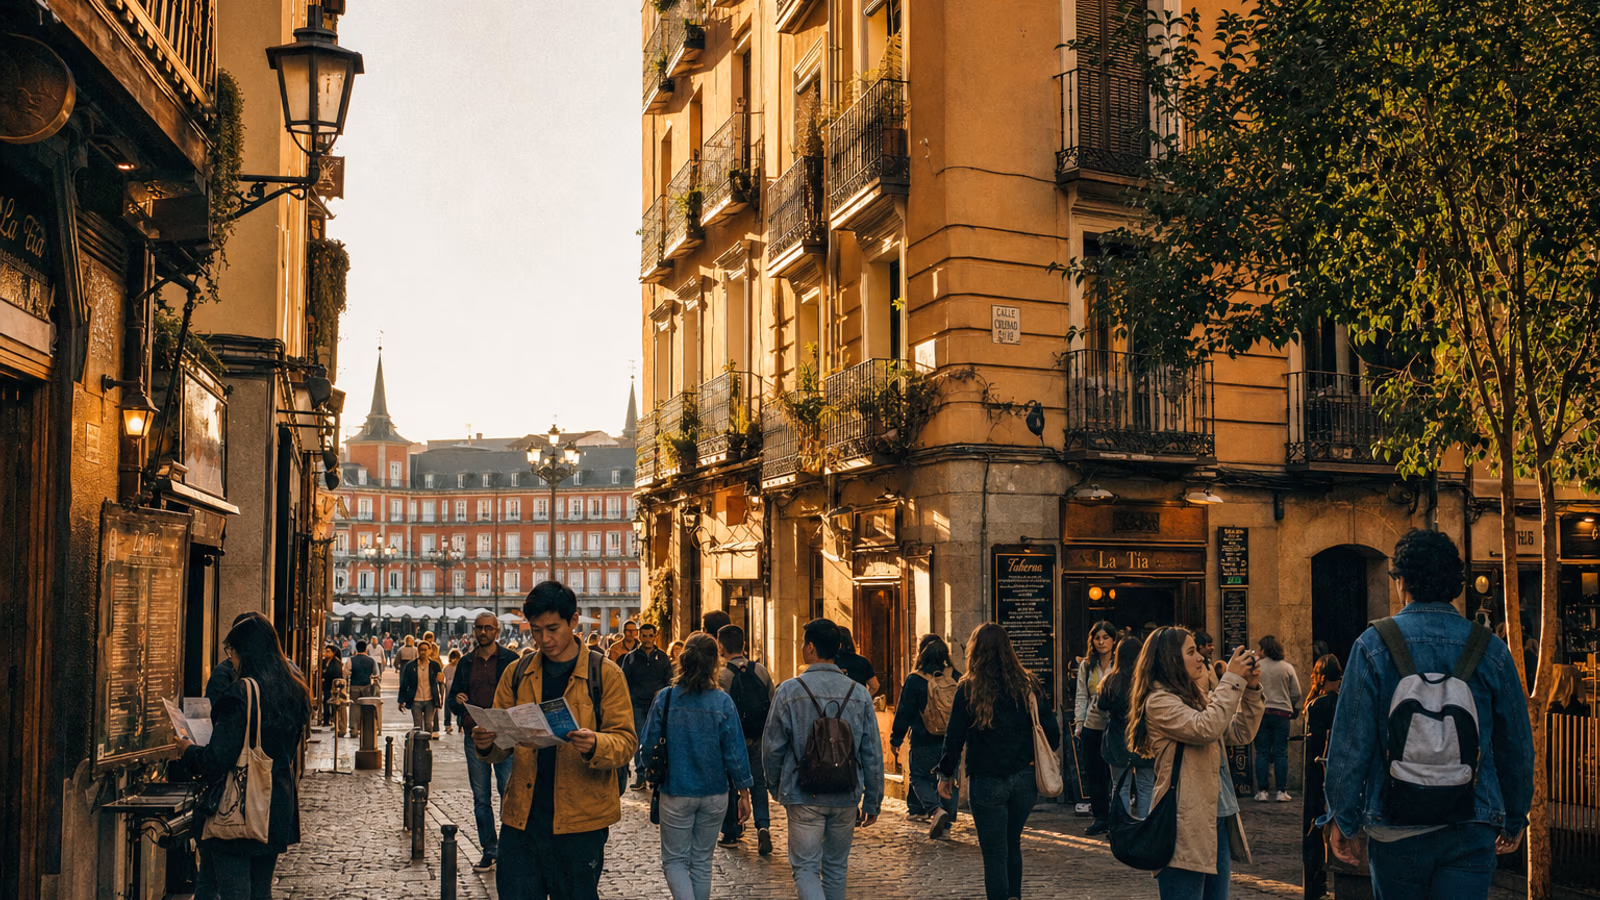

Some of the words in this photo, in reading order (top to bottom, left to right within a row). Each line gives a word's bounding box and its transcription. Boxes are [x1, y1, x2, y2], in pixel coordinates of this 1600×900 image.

[0, 198, 18, 240] La
[997, 308, 1015, 318] CALLE
[1099, 551, 1116, 568] La
[1127, 551, 1148, 568] Tía
